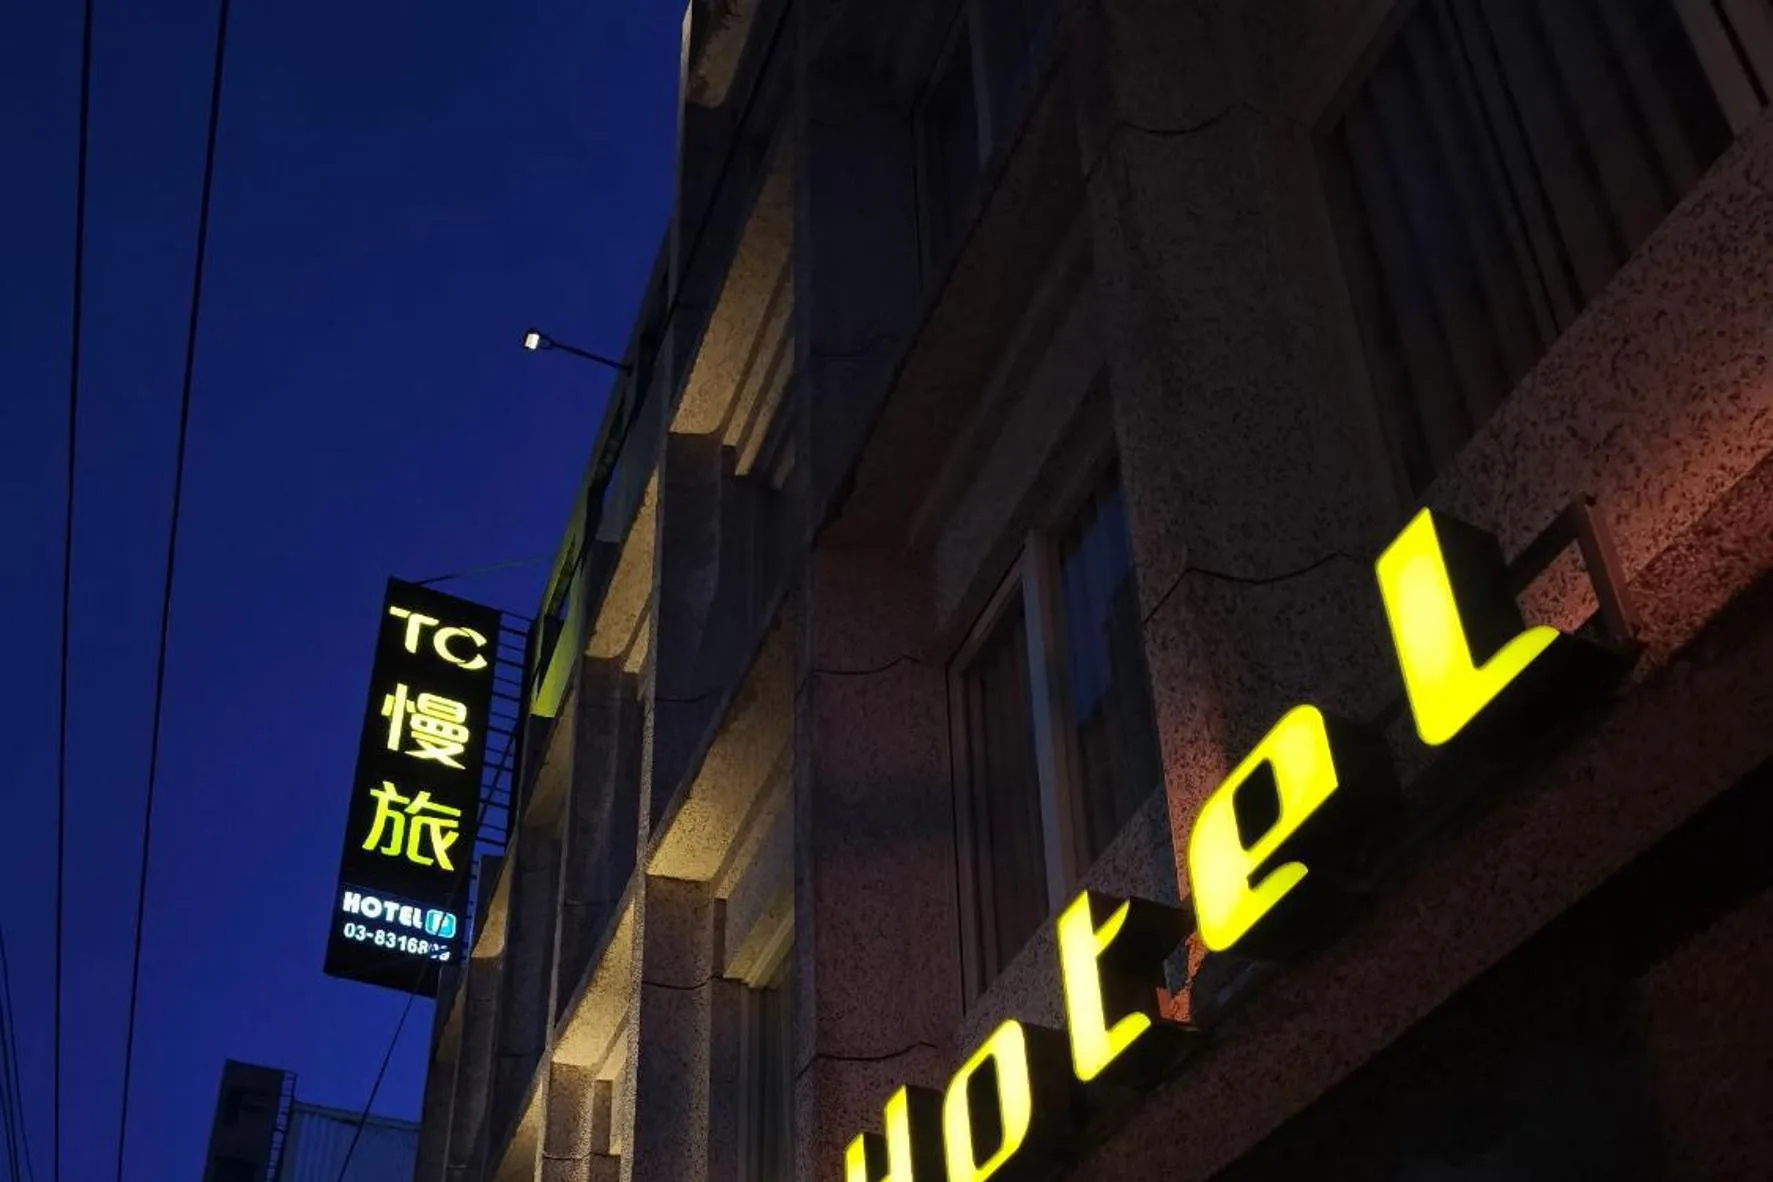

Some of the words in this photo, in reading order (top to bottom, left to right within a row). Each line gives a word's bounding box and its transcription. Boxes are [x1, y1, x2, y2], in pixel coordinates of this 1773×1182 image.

[389, 606, 488, 671] TC
[362, 683, 471, 872] 慢旅
[342, 891, 424, 929] HOTEL
